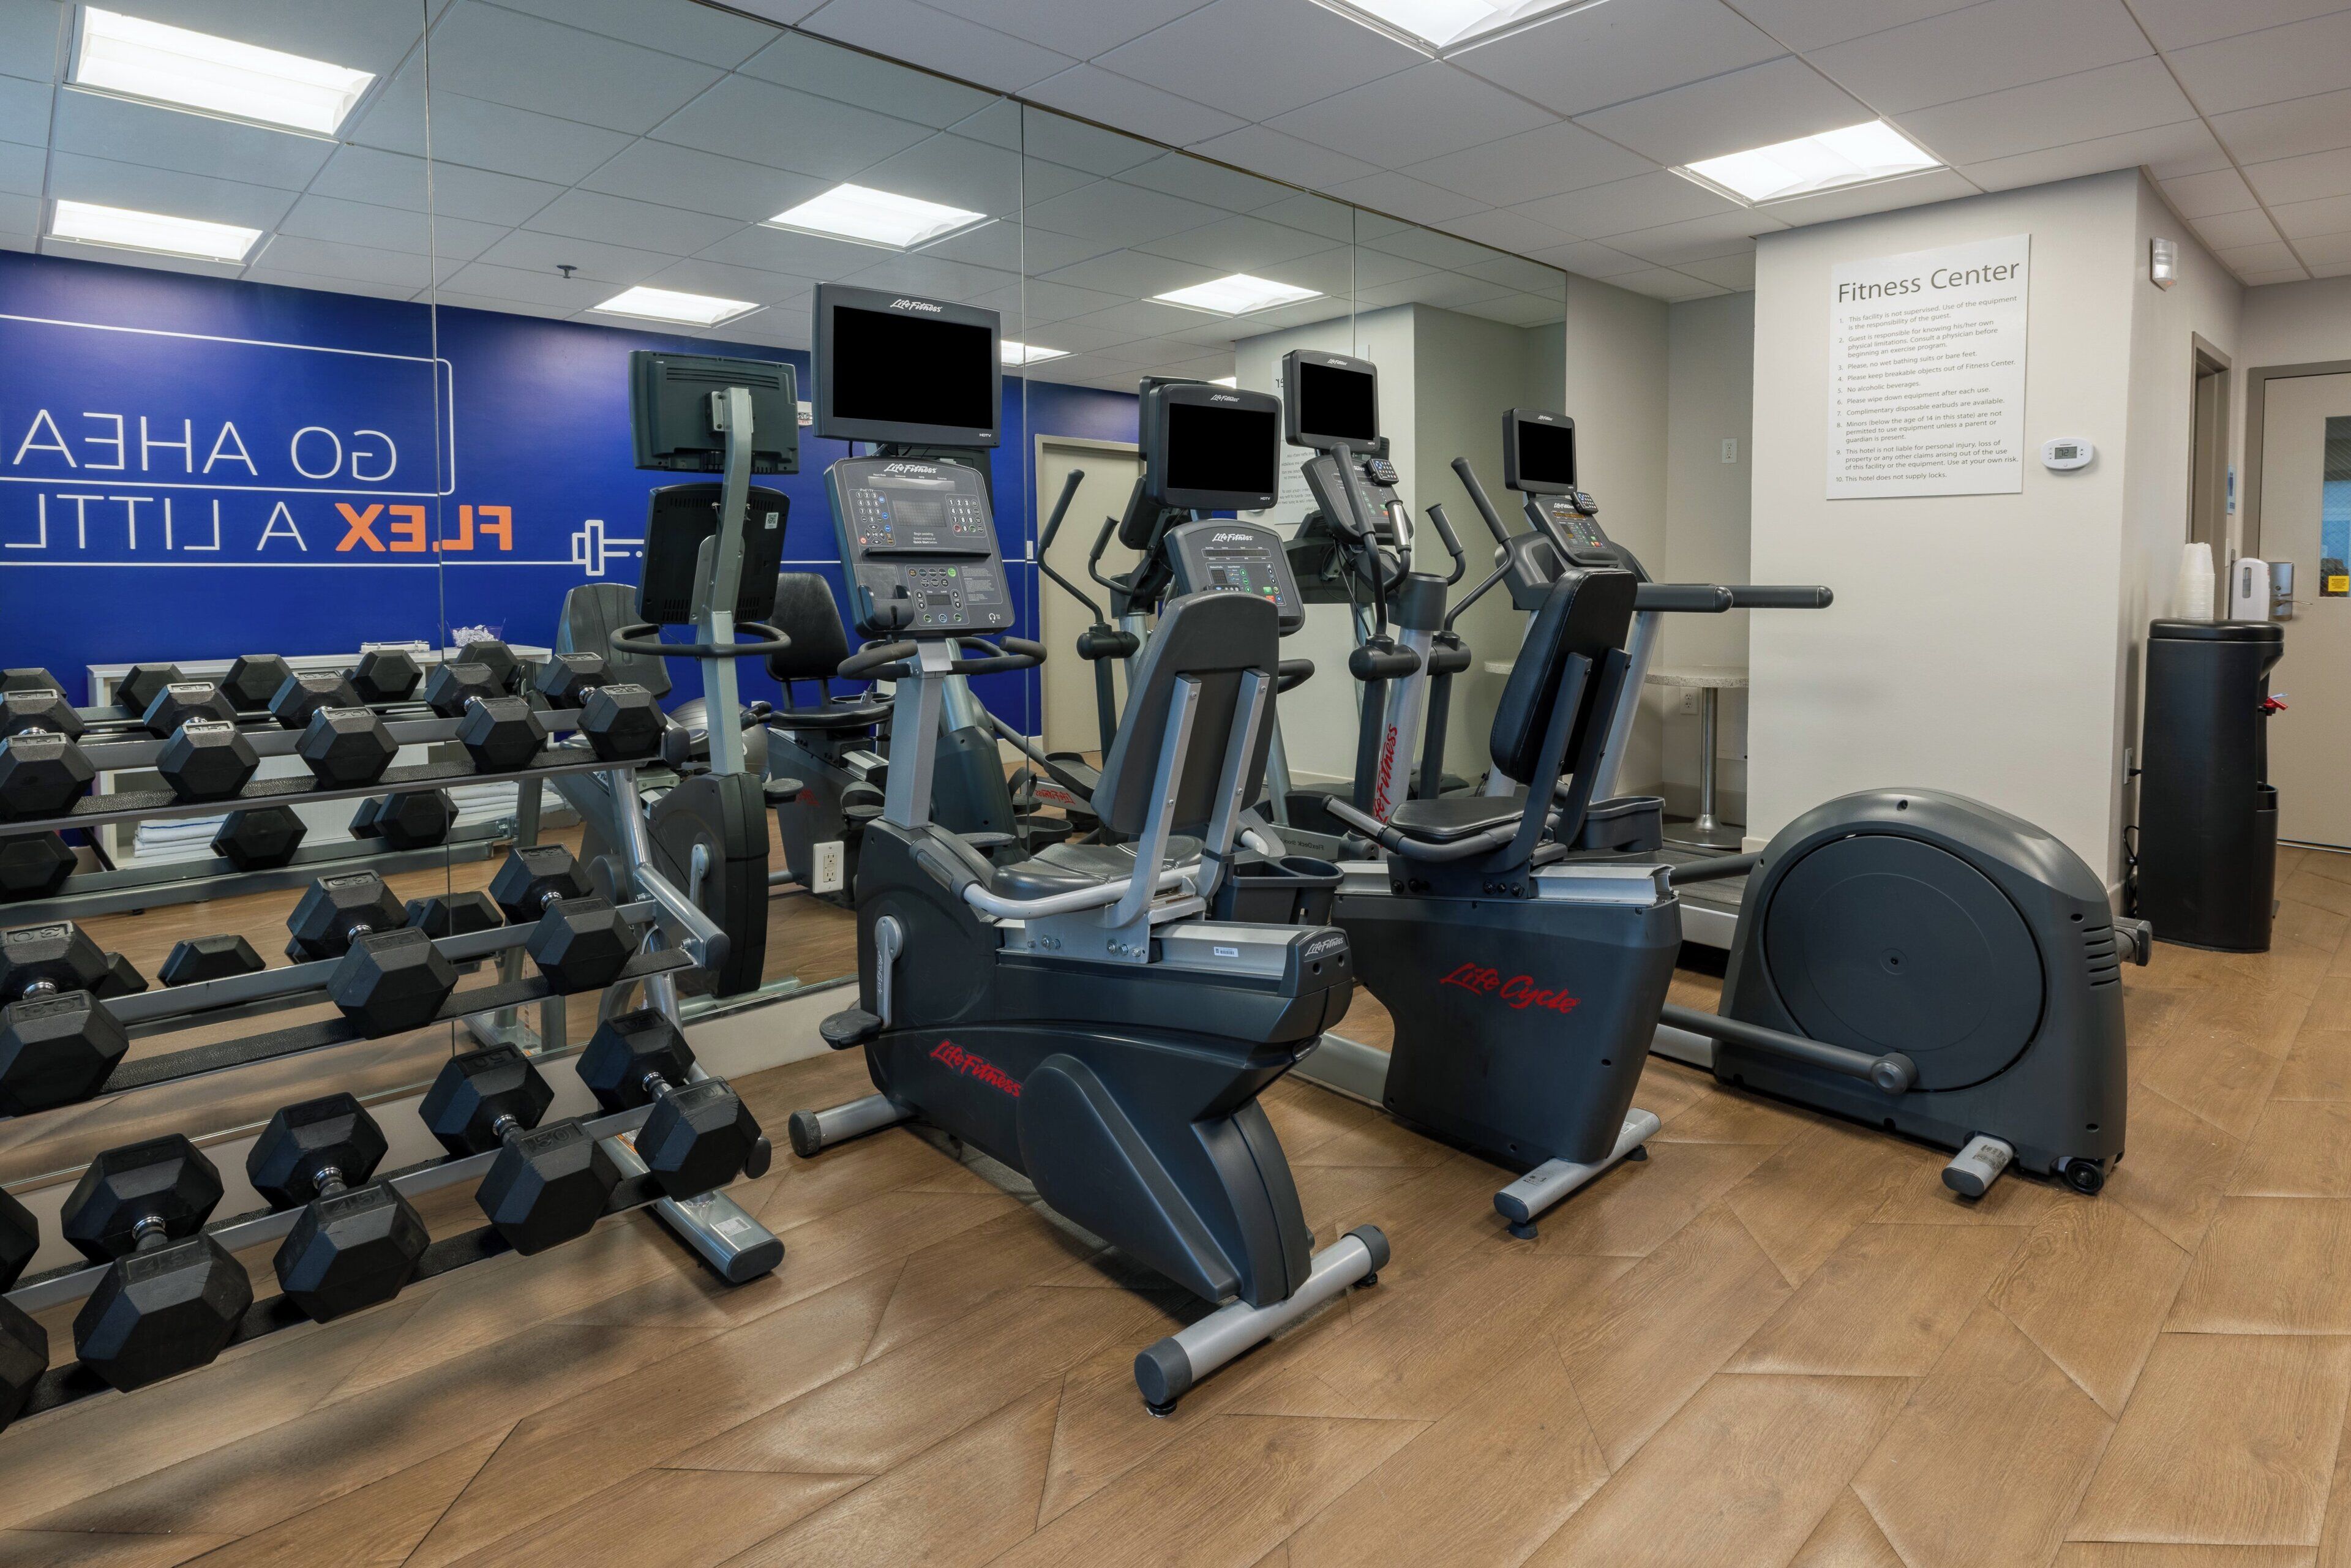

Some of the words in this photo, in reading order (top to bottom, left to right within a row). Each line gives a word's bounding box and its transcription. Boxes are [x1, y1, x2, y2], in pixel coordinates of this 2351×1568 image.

[1839, 277, 1921, 302] Fitness
[1930, 263, 2019, 289] Center
[1903, 305, 1940, 315] supervised.
[1978, 295, 2017, 306] equipment
[1866, 318, 1908, 328] responsibility
[1930, 312, 1951, 321] guest.
[1848, 341, 1872, 351] physical
[1941, 331, 1973, 340] physician
[1874, 329, 1910, 339] responsible
[1848, 350, 1879, 358] beginning
[1917, 343, 1947, 351] program.
[1884, 369, 1916, 377] breakable
[1903, 391, 1939, 400] equipment
[1846, 407, 1894, 416] Complimentary
[1895, 403, 1930, 412] disposable
[1846, 427, 1876, 436] permitted
[1899, 424, 1934, 432] equipment
[1925, 442, 1954, 451] personal
[1440, 962, 1500, 996] Life
